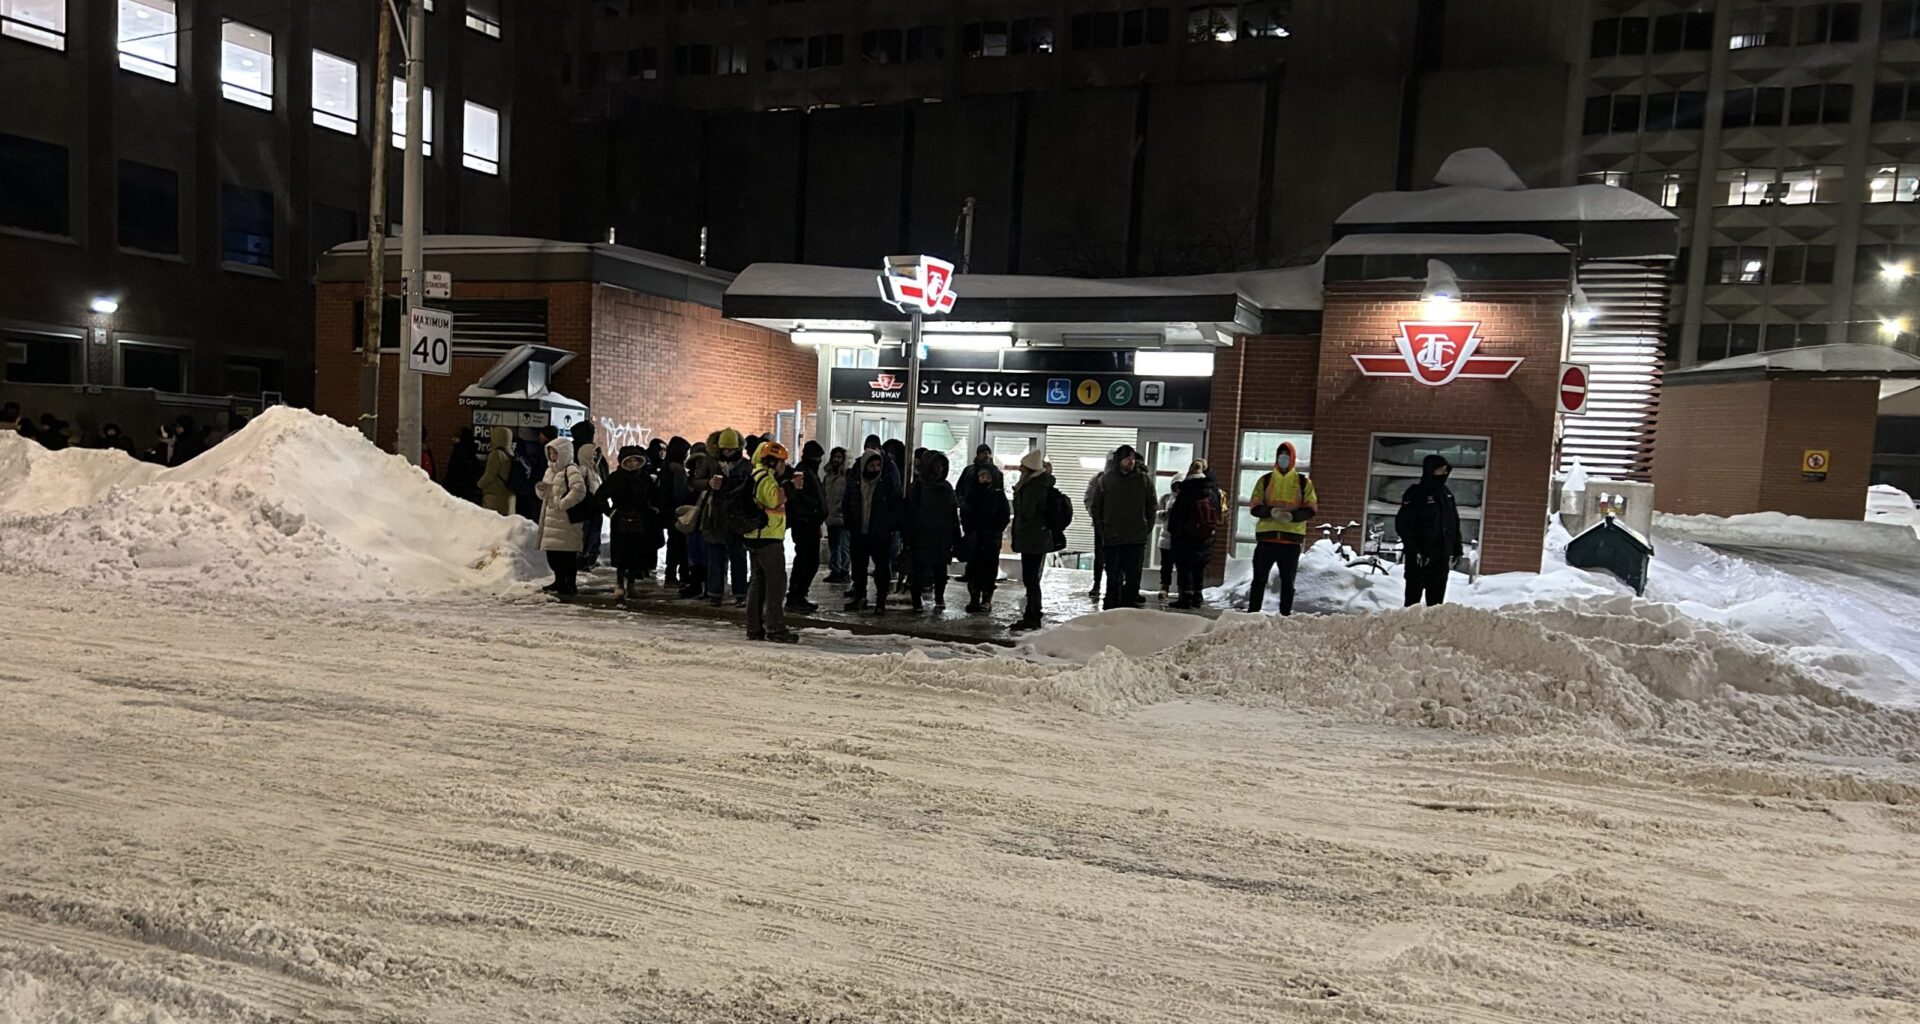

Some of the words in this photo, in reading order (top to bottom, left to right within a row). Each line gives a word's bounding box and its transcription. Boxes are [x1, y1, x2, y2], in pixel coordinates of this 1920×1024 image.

[425, 281, 449, 290] STANDING
[413, 314, 449, 329] MAXIMUM
[412, 336, 448, 365] 40
[871, 391, 901, 399] SUBWAY
[920, 380, 941, 395] ST
[951, 380, 1031, 398] GEORGE
[466, 398, 488, 407] George
[475, 412, 501, 424] 24/7
